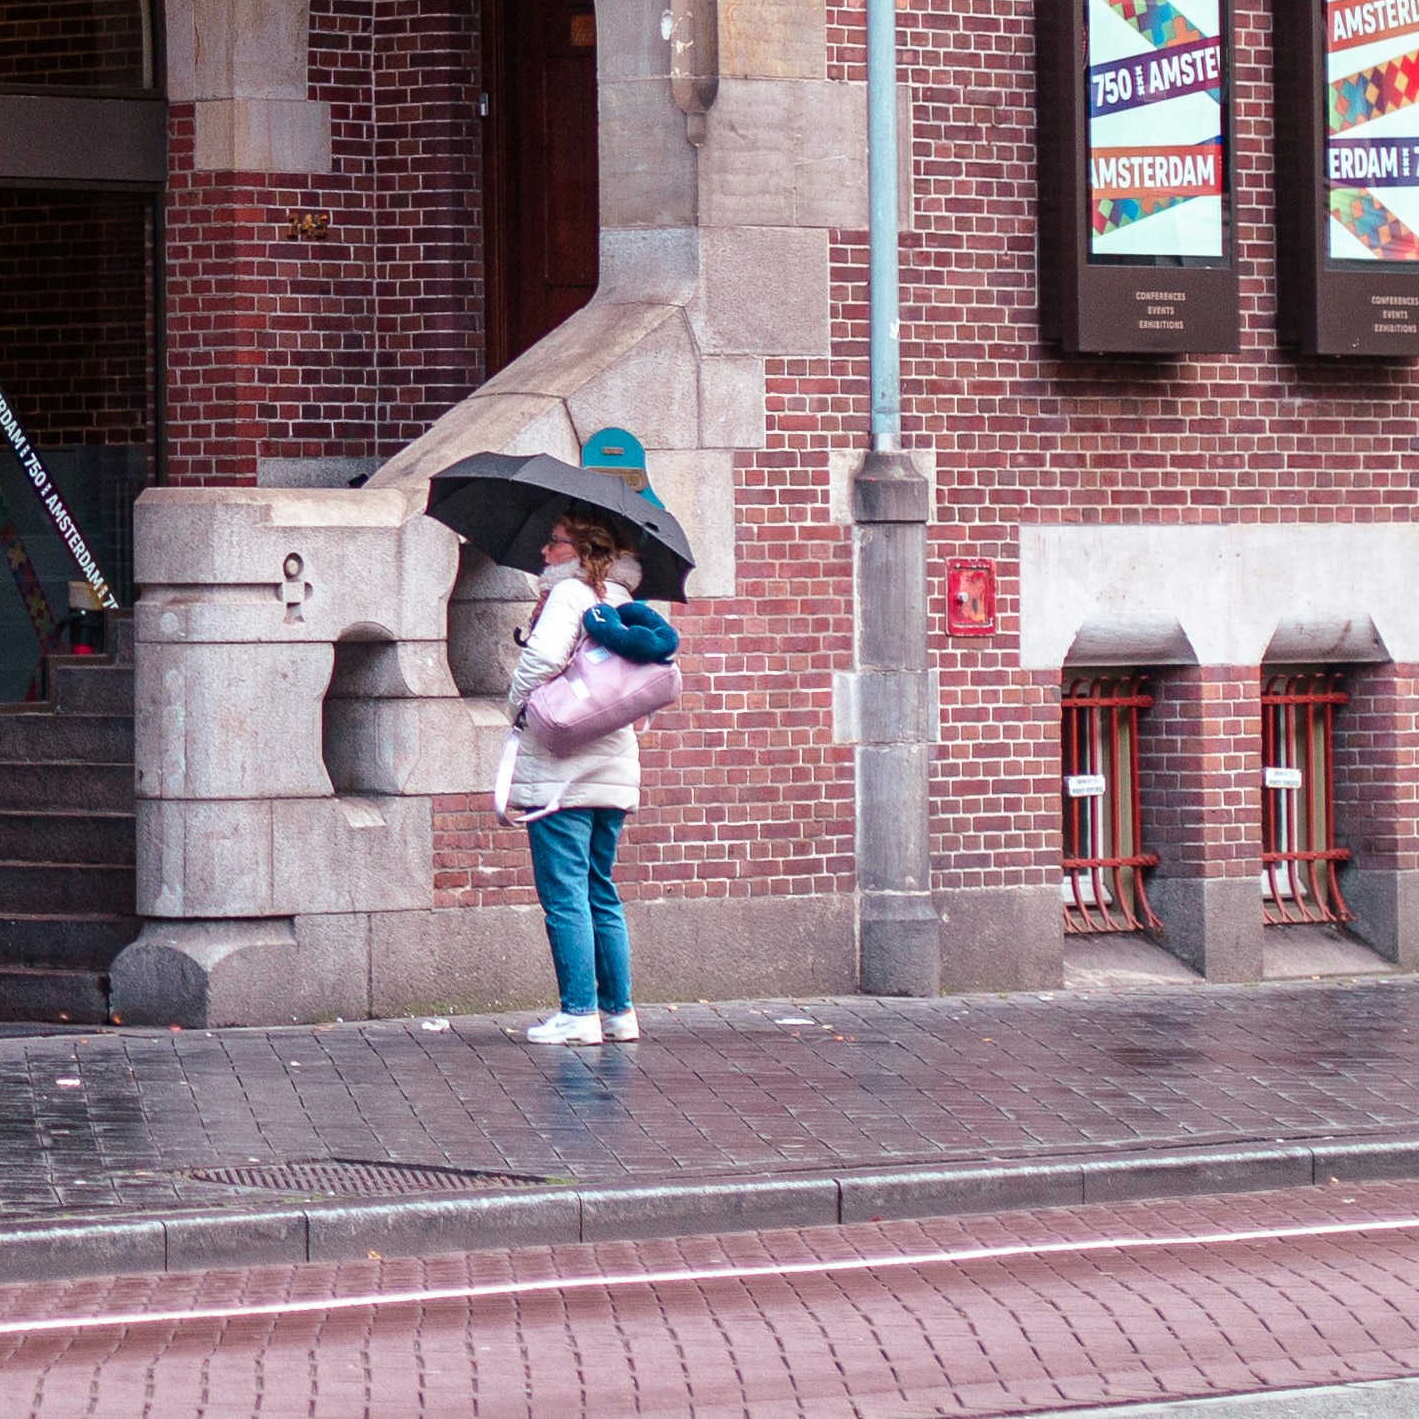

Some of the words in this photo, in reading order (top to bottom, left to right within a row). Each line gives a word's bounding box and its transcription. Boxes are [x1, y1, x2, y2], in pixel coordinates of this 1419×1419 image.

[1093, 68, 1132, 107] 750
[1150, 45, 1220, 94] AMSTE
[1329, 147, 1398, 179] ERDAM
[1136, 292, 1186, 301] CONFERENCES
[1148, 306, 1175, 315] EVENTS
[1139, 320, 1184, 329] EXHIBITIONS
[24, 452, 47, 487] 750
[45, 493, 104, 591] AMSTERDAM
